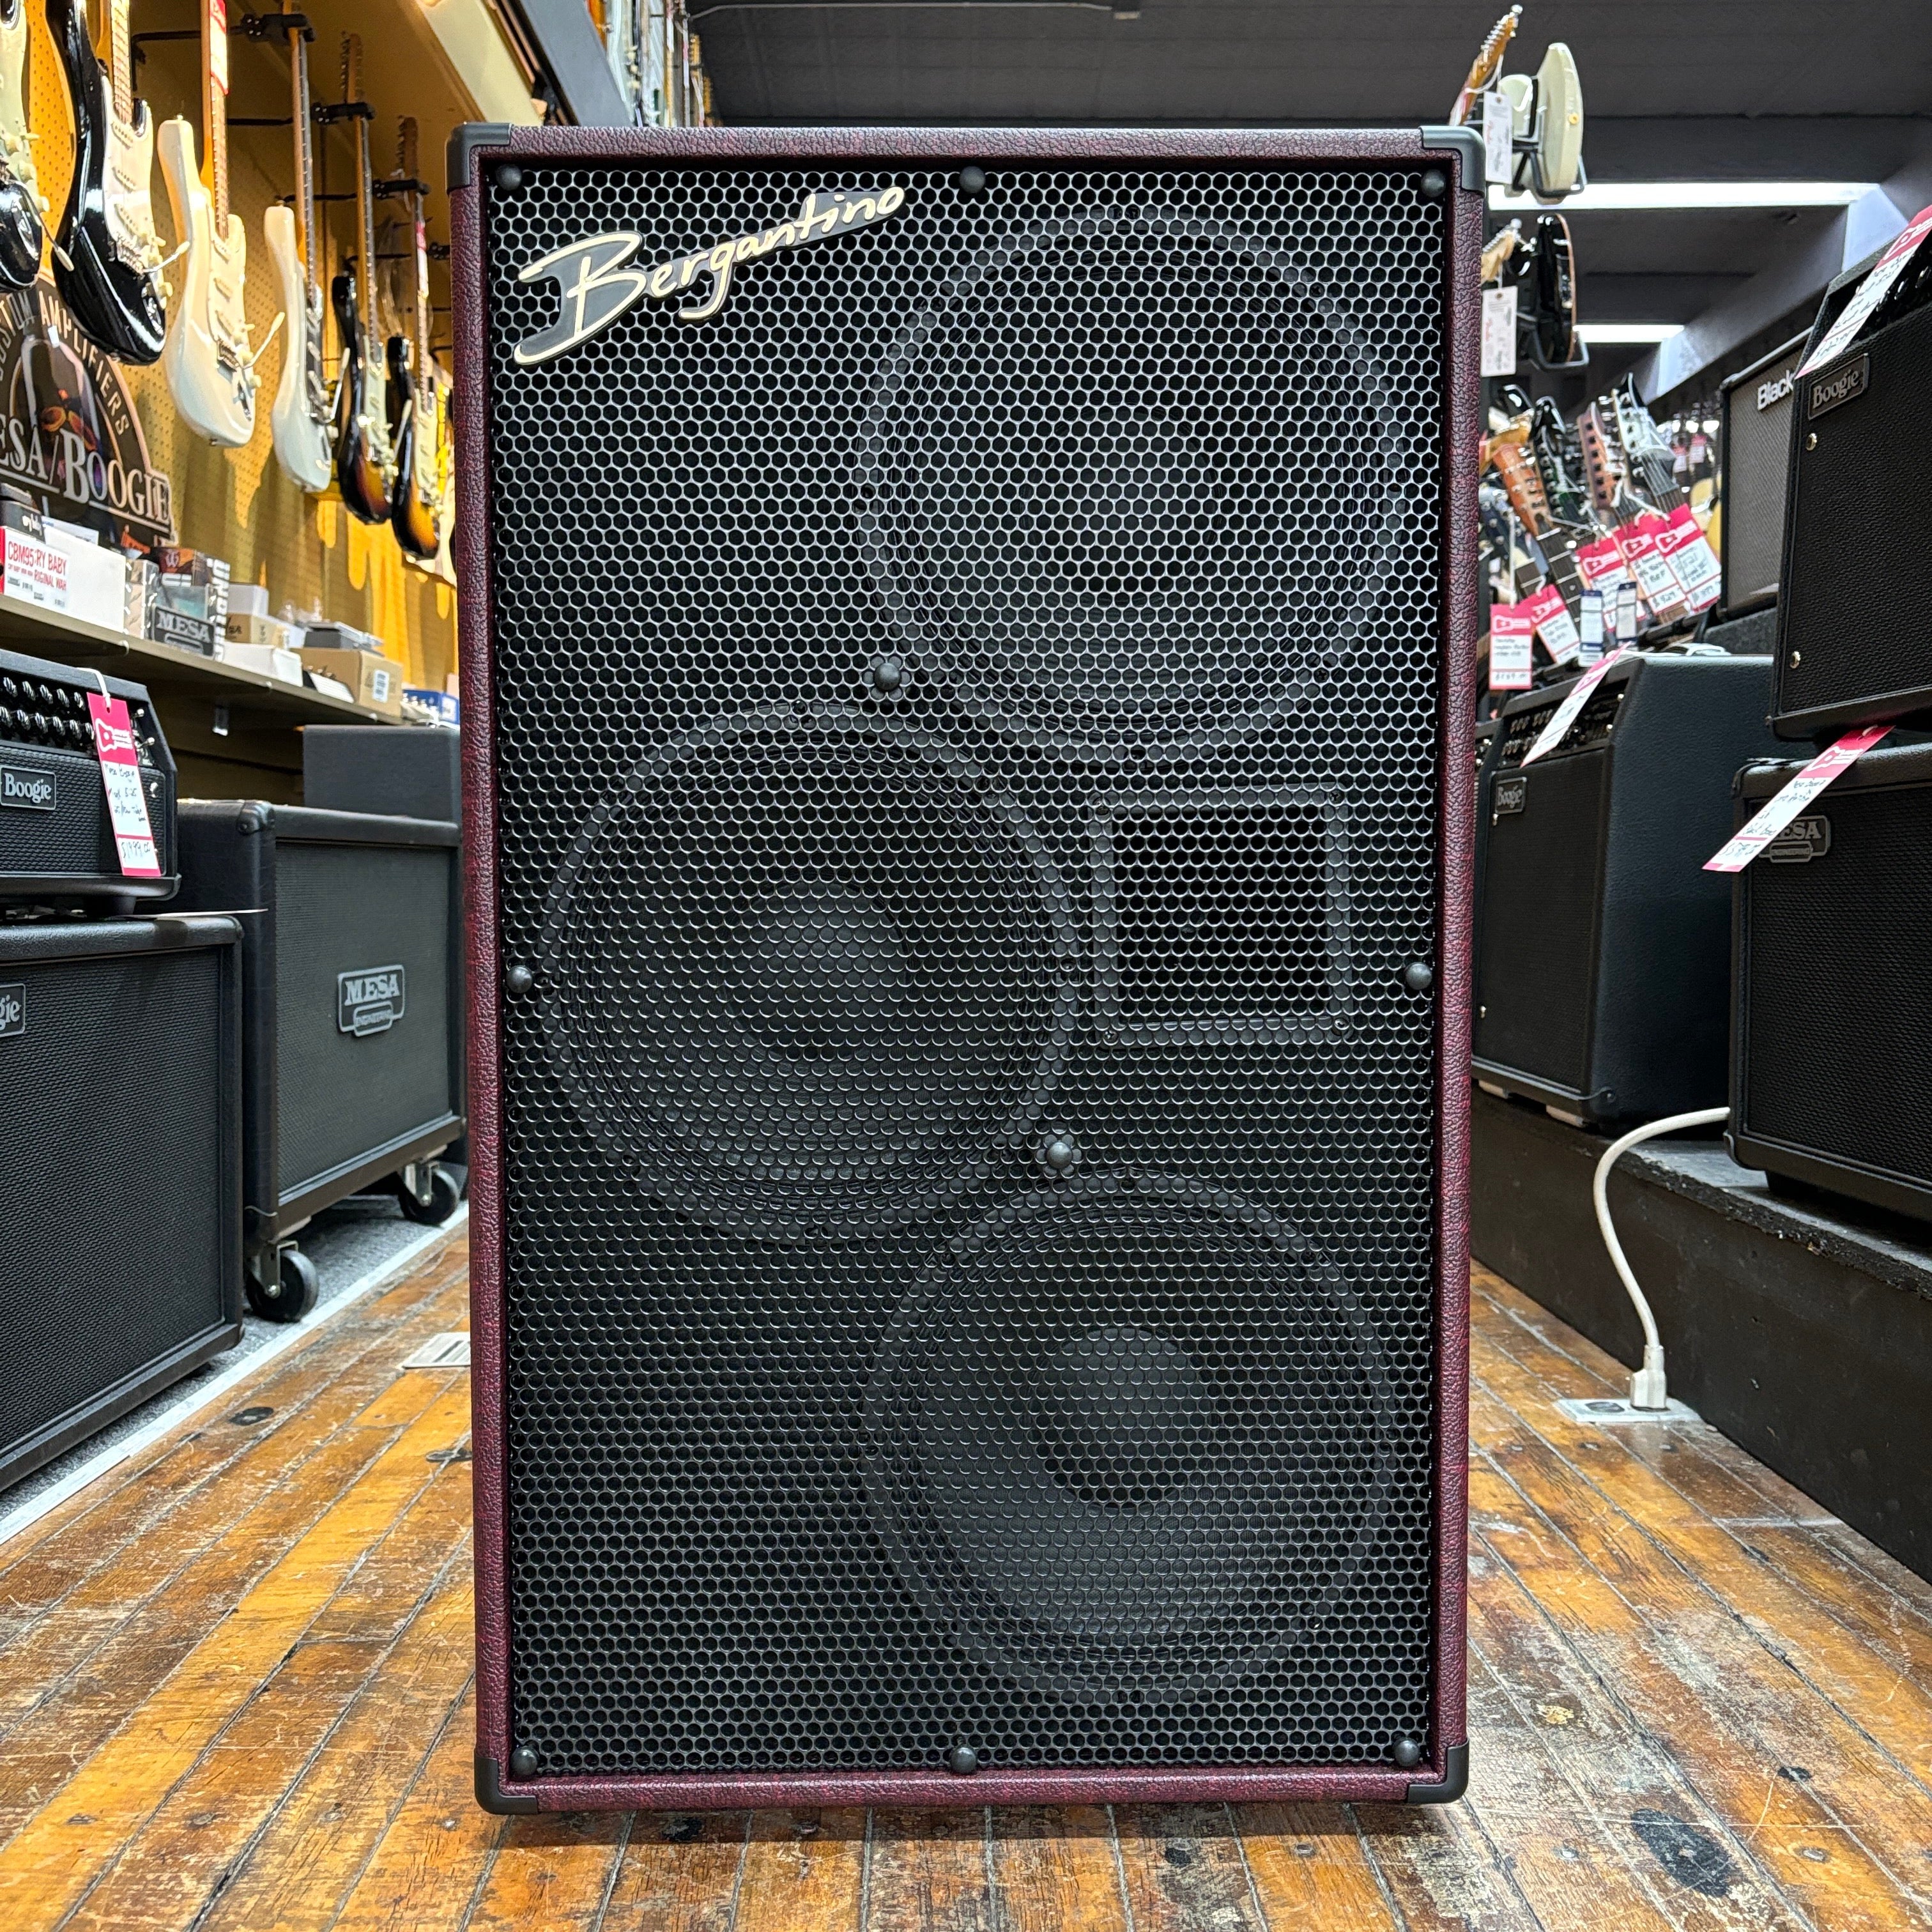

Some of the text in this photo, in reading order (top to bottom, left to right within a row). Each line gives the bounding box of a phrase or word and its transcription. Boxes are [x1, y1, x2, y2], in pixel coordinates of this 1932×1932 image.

[513, 186, 906, 366] Bergantino
[39, 291, 129, 435] AMPLIFIERS
[1813, 369, 1860, 409] Boogie
[34, 549, 67, 576] RY BABY
[157, 611, 212, 644] MESA
[4, 772, 52, 804] Boogie
[1498, 785, 1522, 808] Boogie
[1774, 821, 1822, 840] ESA
[344, 974, 401, 1006] MESA
